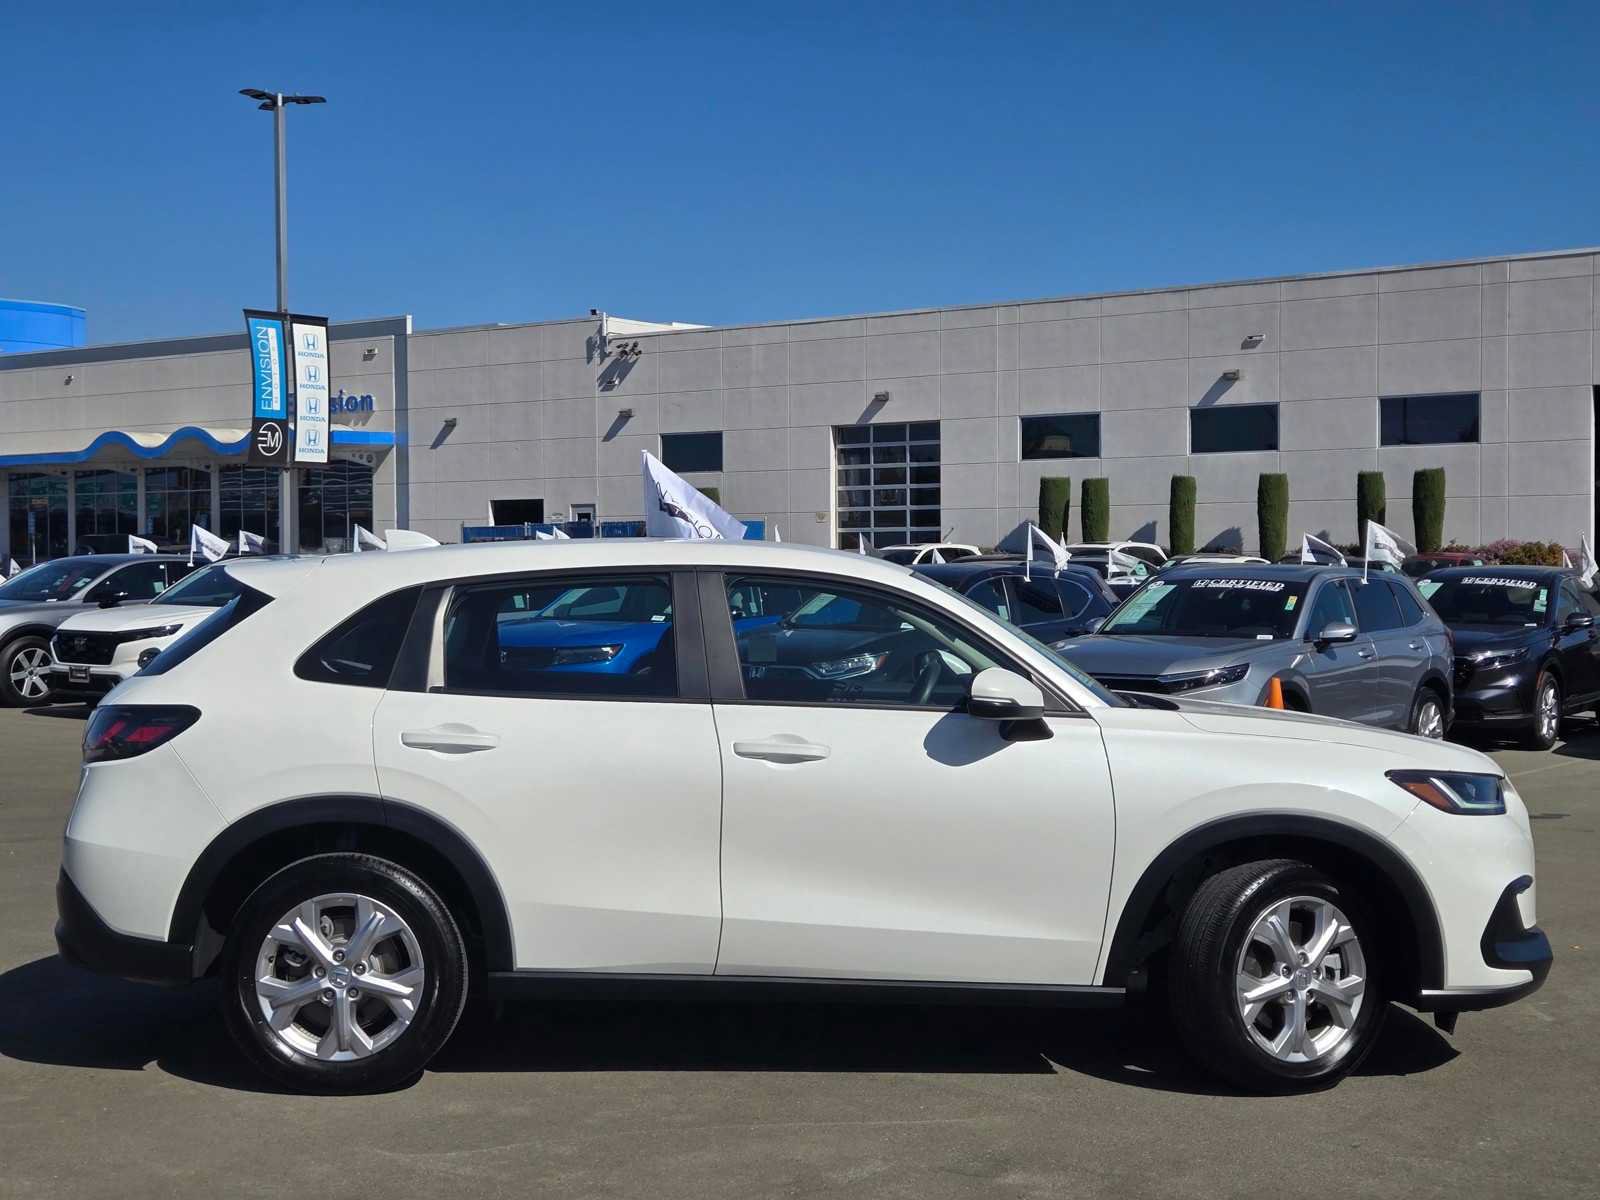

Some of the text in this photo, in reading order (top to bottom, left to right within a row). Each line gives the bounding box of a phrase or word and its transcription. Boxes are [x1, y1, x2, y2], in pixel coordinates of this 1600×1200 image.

[298, 351, 325, 359] HONDA
[256, 326, 273, 411] ENVISION
[299, 383, 326, 391] HONDA
[299, 415, 326, 423] HONDA
[298, 447, 325, 455] HONDA
[1210, 579, 1285, 588] CERTIFIED
